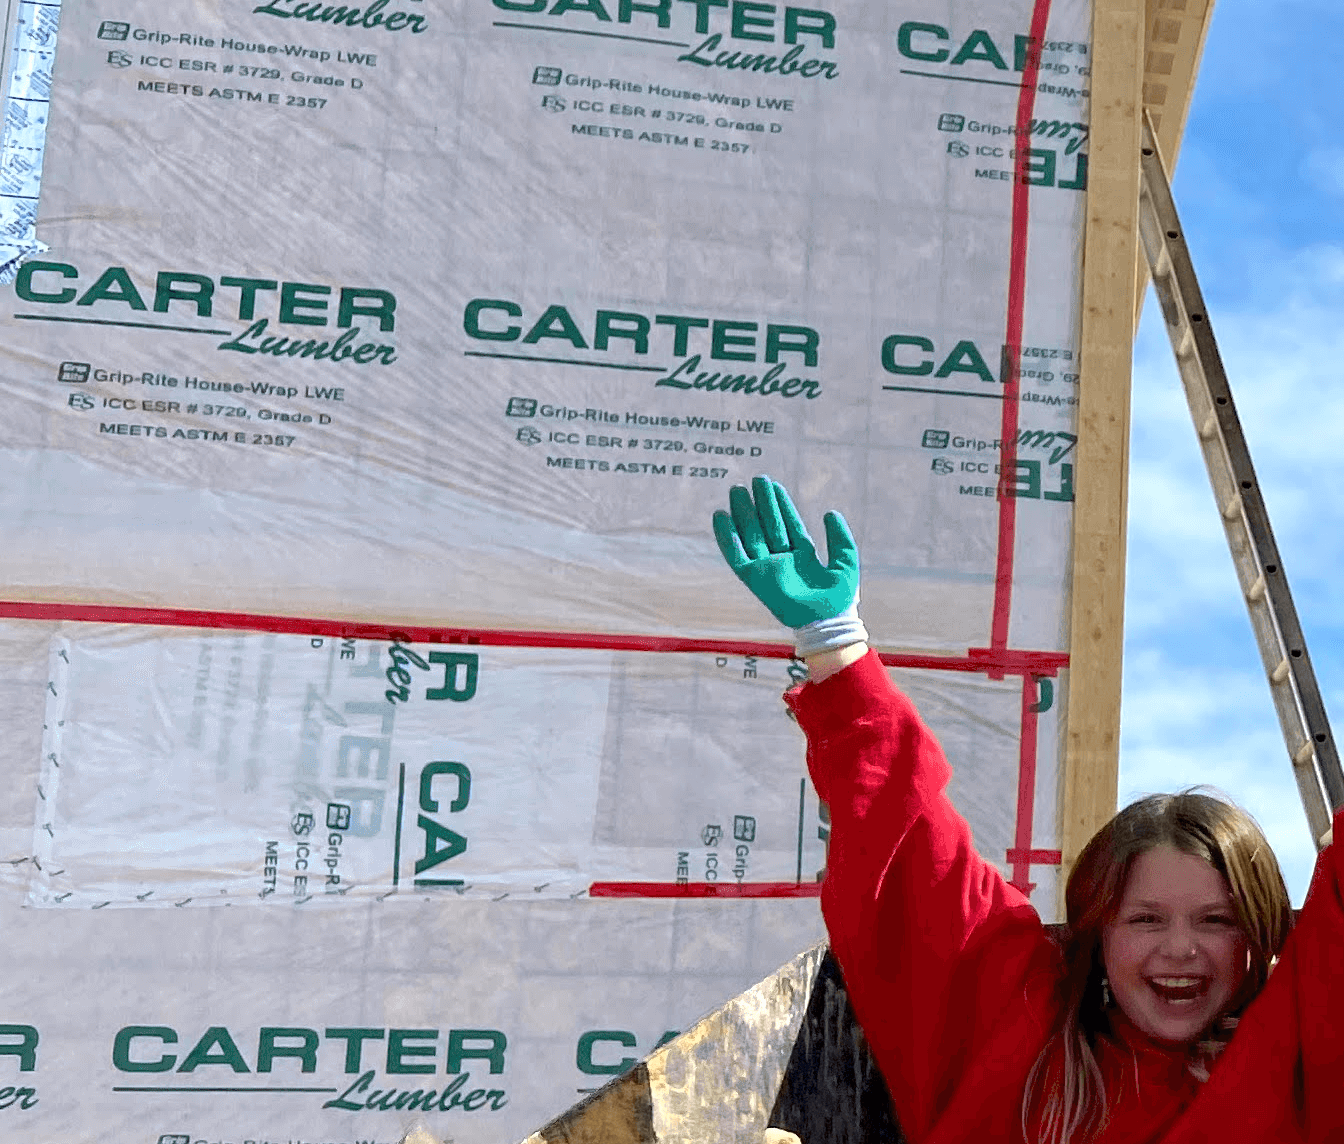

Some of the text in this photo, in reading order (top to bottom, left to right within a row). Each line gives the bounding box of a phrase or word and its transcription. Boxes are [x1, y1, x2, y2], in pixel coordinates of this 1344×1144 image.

[133, 29, 214, 47] Grip-Rite
[221, 39, 330, 62] House-Wrap
[338, 51, 376, 66] LWE
[678, 33, 840, 80] Lumber
[140, 55, 172, 68] ICC
[179, 59, 216, 72] ESR
[291, 72, 344, 86] Grade
[351, 78, 363, 89] D
[138, 81, 327, 109] MEETS ASTM E 2357
[565, 74, 642, 93] Grip-Rite
[648, 84, 751, 109] House-Wrap
[757, 97, 793, 111] LWE
[573, 100, 604, 112] ICC
[610, 104, 646, 117] ESR
[715, 118, 764, 132] Grade
[770, 123, 782, 133] D
[572, 124, 749, 154] MEETS ASTM E 2357
[976, 146, 1004, 157] ICC
[14, 260, 398, 333] CARTER
[217, 318, 399, 366] Lumber
[463, 299, 819, 368] CARTER
[94, 369, 178, 387] Grip-Rite
[185, 377, 298, 399] House-Wrap
[305, 386, 344, 401] LWE
[655, 354, 823, 400] Lumber
[103, 398, 137, 410] ICC
[142, 400, 180, 413] ESR
[187, 404, 198, 414] #
[258, 409, 312, 423] Grade
[319, 414, 331, 424] D
[540, 405, 619, 423] Grip-Rite
[626, 412, 730, 433] House-Wrap
[737, 420, 774, 433] LWE
[100, 423, 296, 447] MEETS ASTM E 2357
[549, 432, 579, 444] ICC
[586, 435, 622, 448] ESR
[628, 439, 638, 448] #
[694, 442, 744, 455] Grade
[750, 447, 762, 457] D
[547, 457, 728, 478] MEETS ASTM E 2357
[961, 462, 988, 473] ICC
[296, 842, 310, 870] ICC
[706, 853, 718, 880] ICC
[111, 1025, 508, 1074] CARTER
[322, 1071, 510, 1111] Lumber
